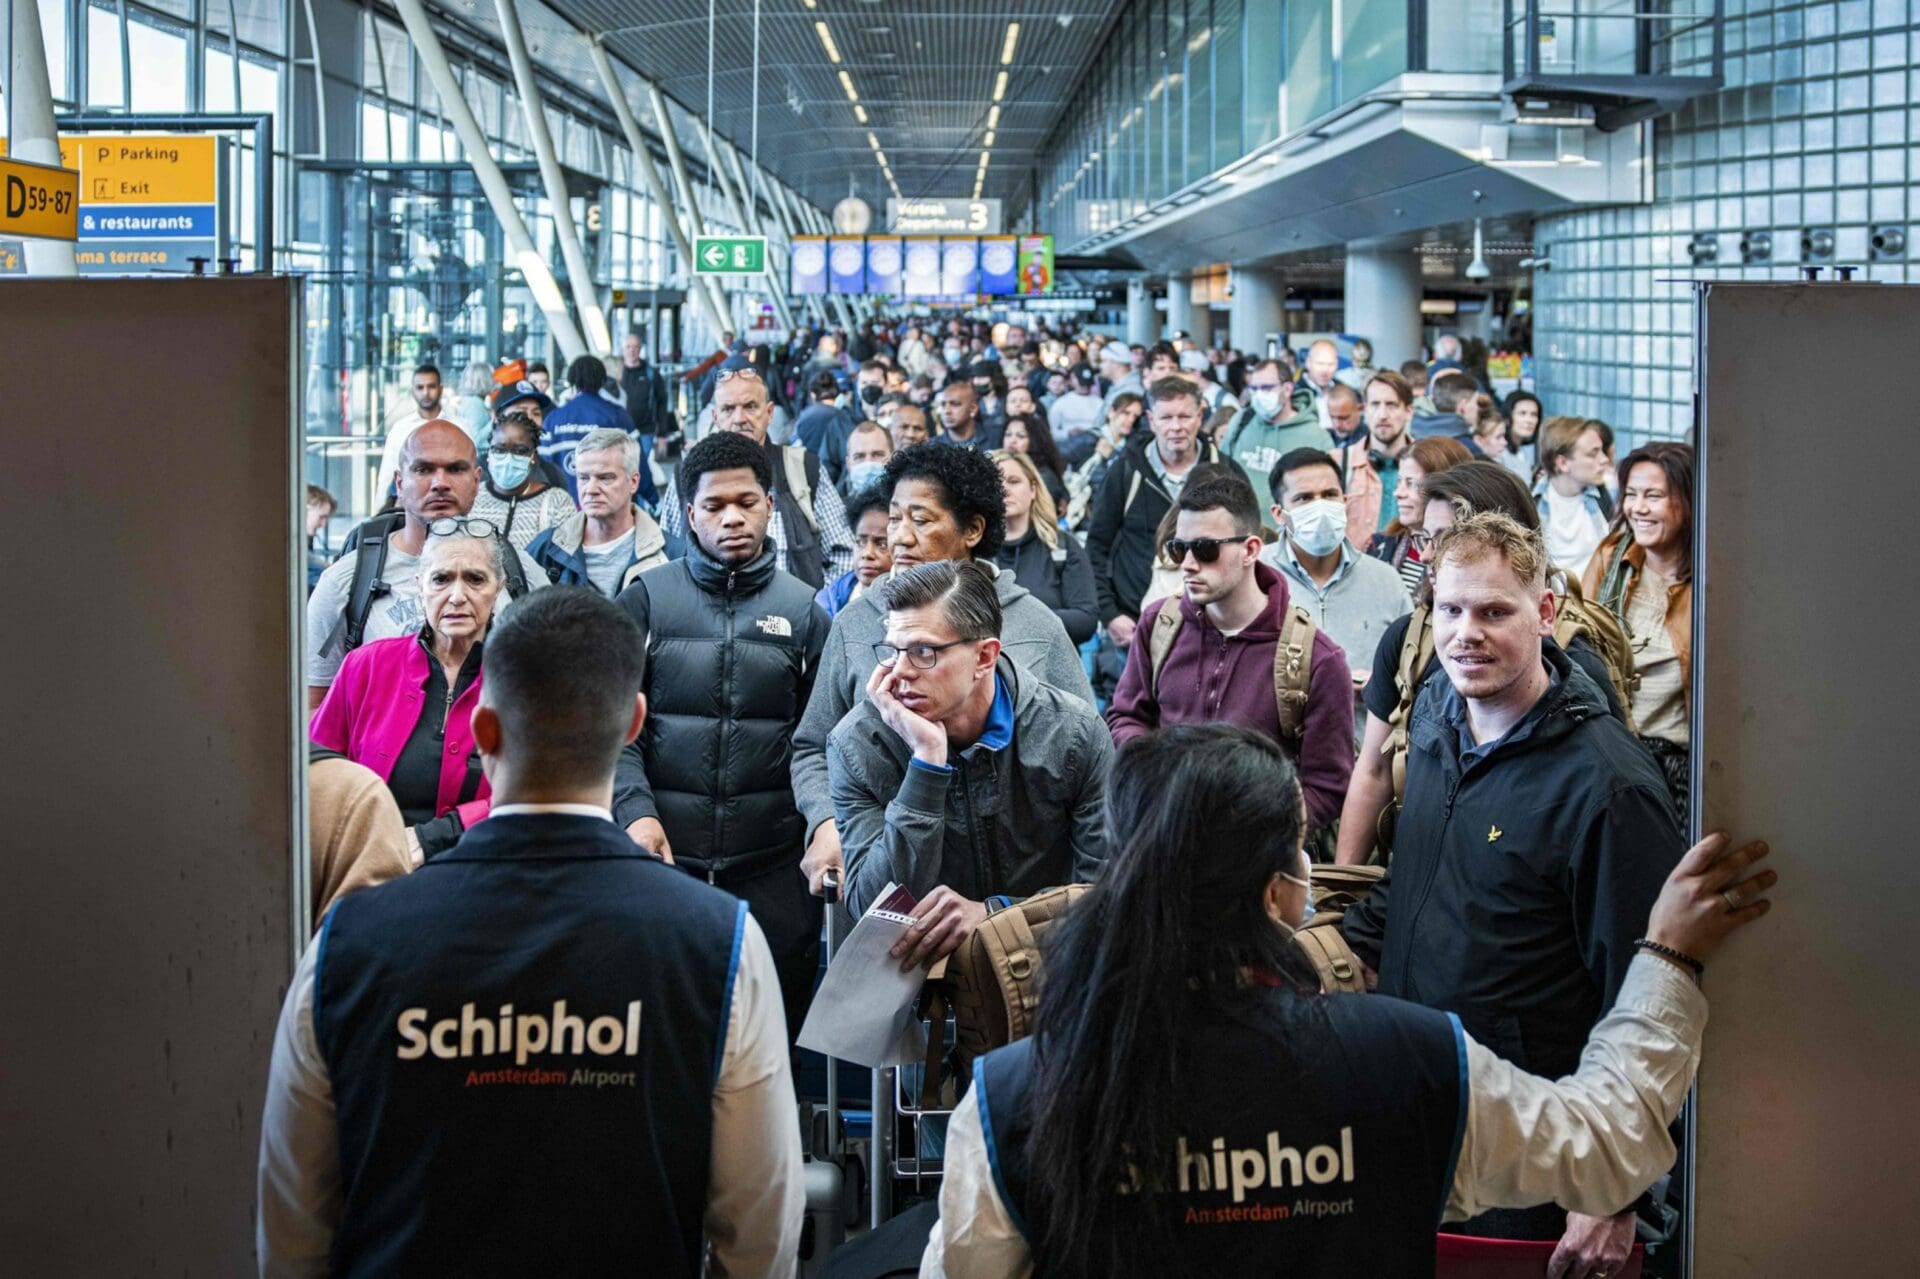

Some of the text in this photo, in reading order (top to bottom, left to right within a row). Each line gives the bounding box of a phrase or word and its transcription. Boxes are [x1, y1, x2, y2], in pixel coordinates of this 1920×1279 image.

[120, 148, 179, 162] Parking
[6, 174, 72, 218] D 59-87
[120, 182, 150, 194] Exit
[83, 215, 193, 230] & restaurants
[968, 203, 988, 231] 3
[110, 250, 167, 264] terrace
[397, 1000, 642, 1065] Schiphol
[465, 1069, 636, 1088] Amsterdam Airport
[1117, 1126, 1354, 1203] hiphol
[1185, 1199, 1354, 1223] Amsterdam Airport
